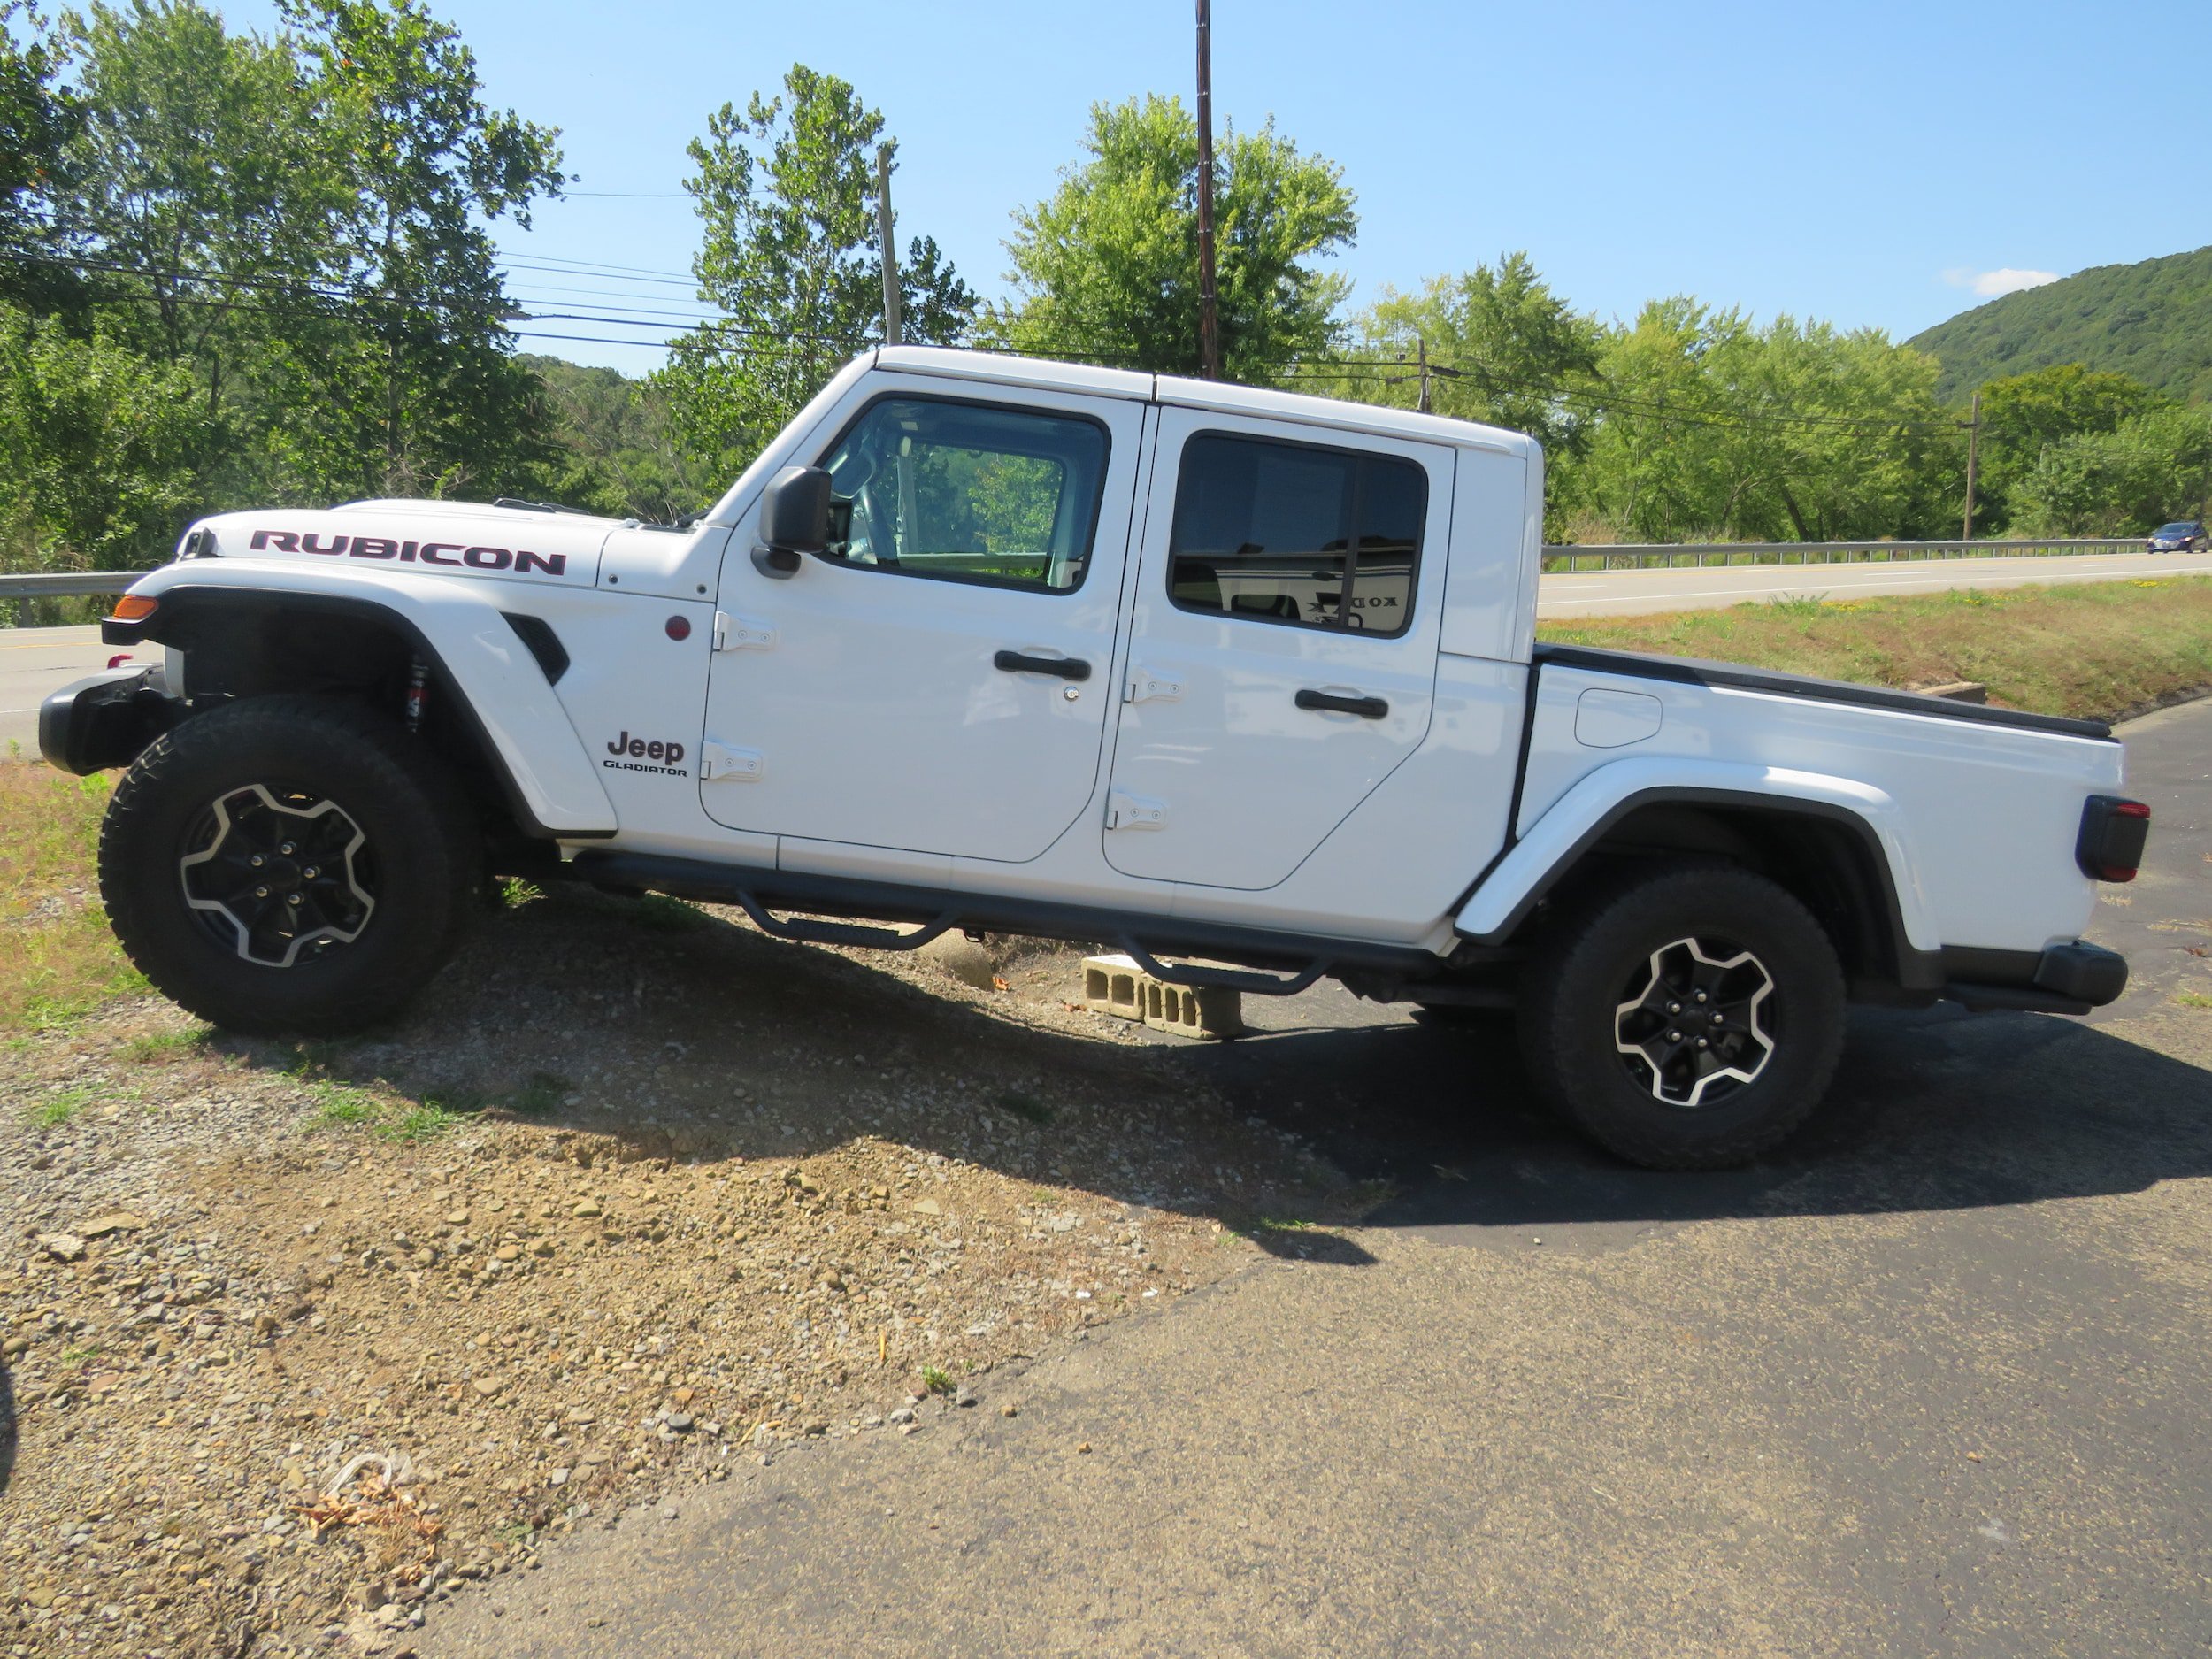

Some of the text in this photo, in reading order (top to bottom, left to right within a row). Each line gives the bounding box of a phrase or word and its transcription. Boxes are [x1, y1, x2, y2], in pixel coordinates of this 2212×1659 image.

[250, 530, 567, 576] RUBICON
[607, 731, 685, 766] Jeep
[603, 760, 688, 778] GLADIATOR
